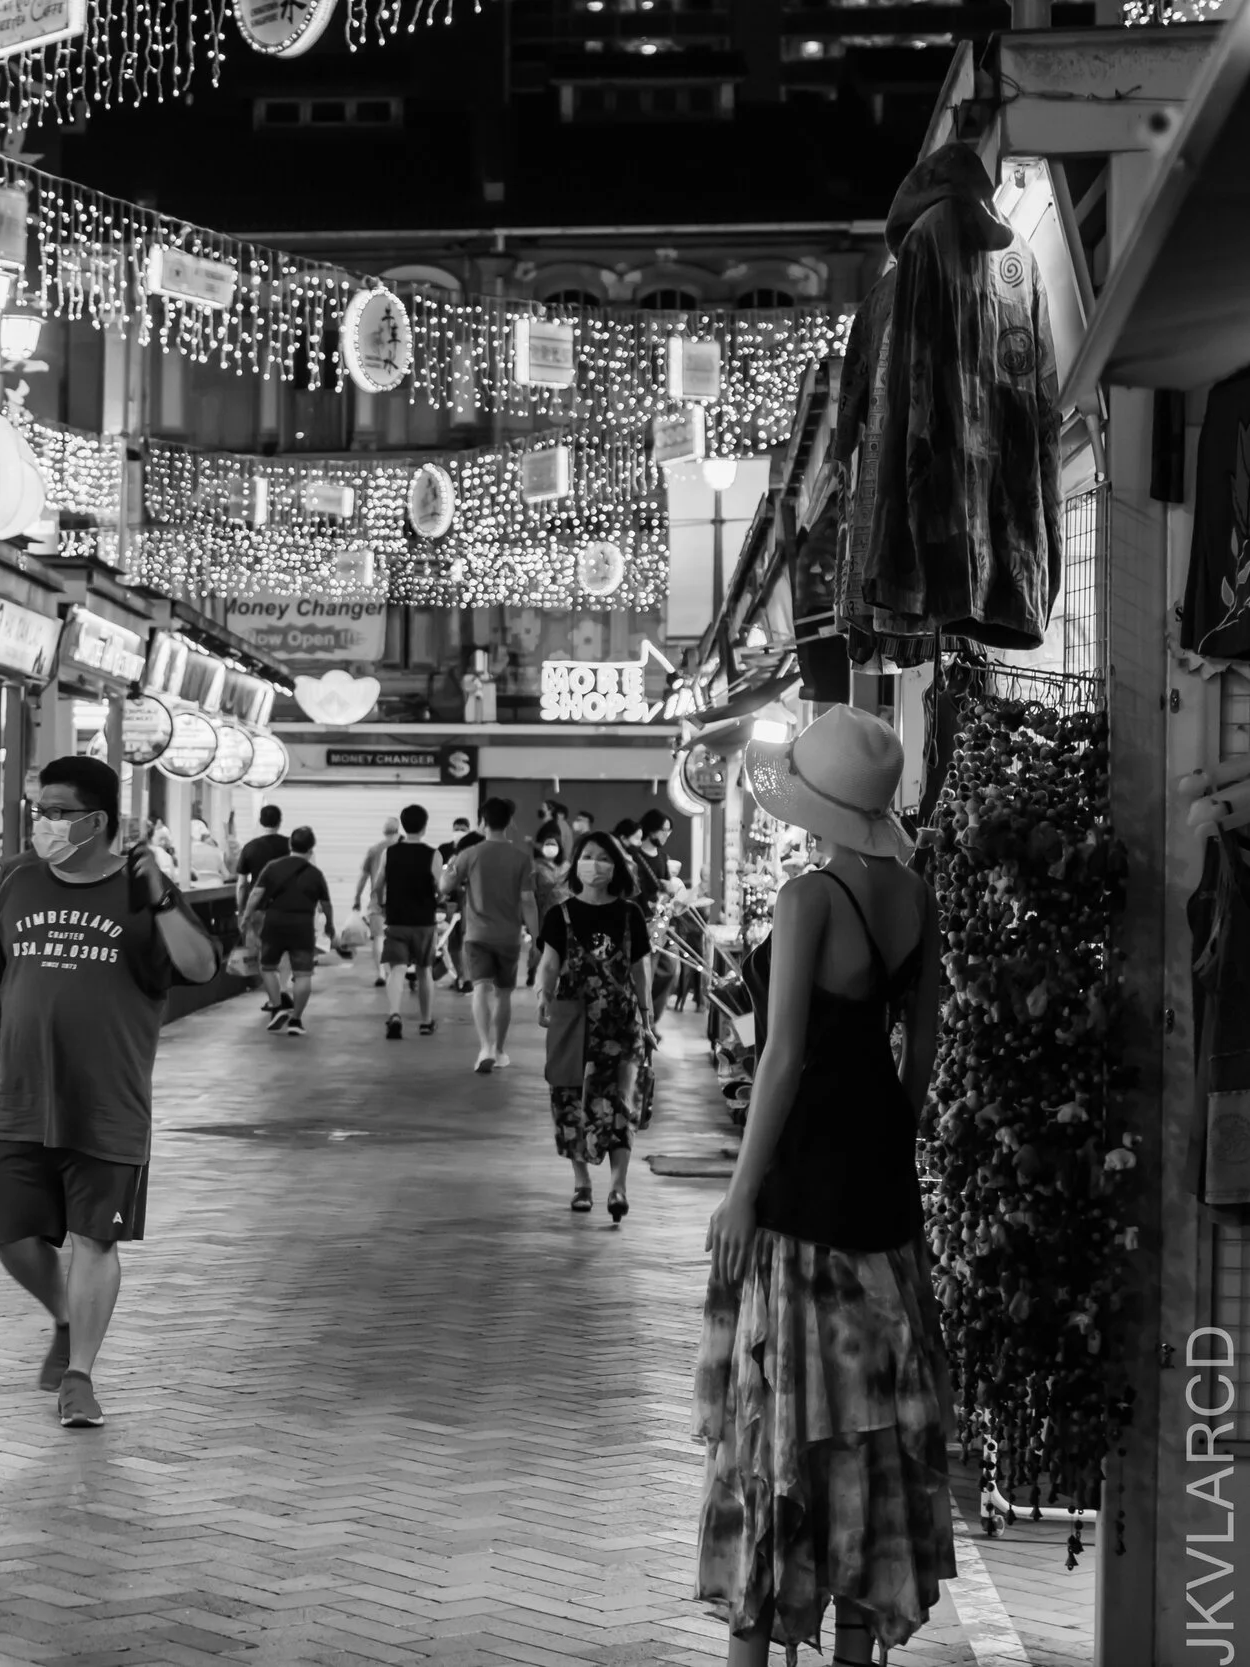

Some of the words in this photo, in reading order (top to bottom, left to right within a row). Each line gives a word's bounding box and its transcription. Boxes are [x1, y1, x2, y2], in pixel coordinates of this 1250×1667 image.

[296, 598, 386, 621] Changer
[287, 630, 335, 648] Open
[540, 666, 644, 695] MORE
[540, 692, 644, 722] SHOPS
[330, 753, 373, 765] MONEY
[376, 754, 435, 765] CHANGER
[15, 910, 123, 938] TIMBERLAND
[47, 930, 85, 941] CRAFTED
